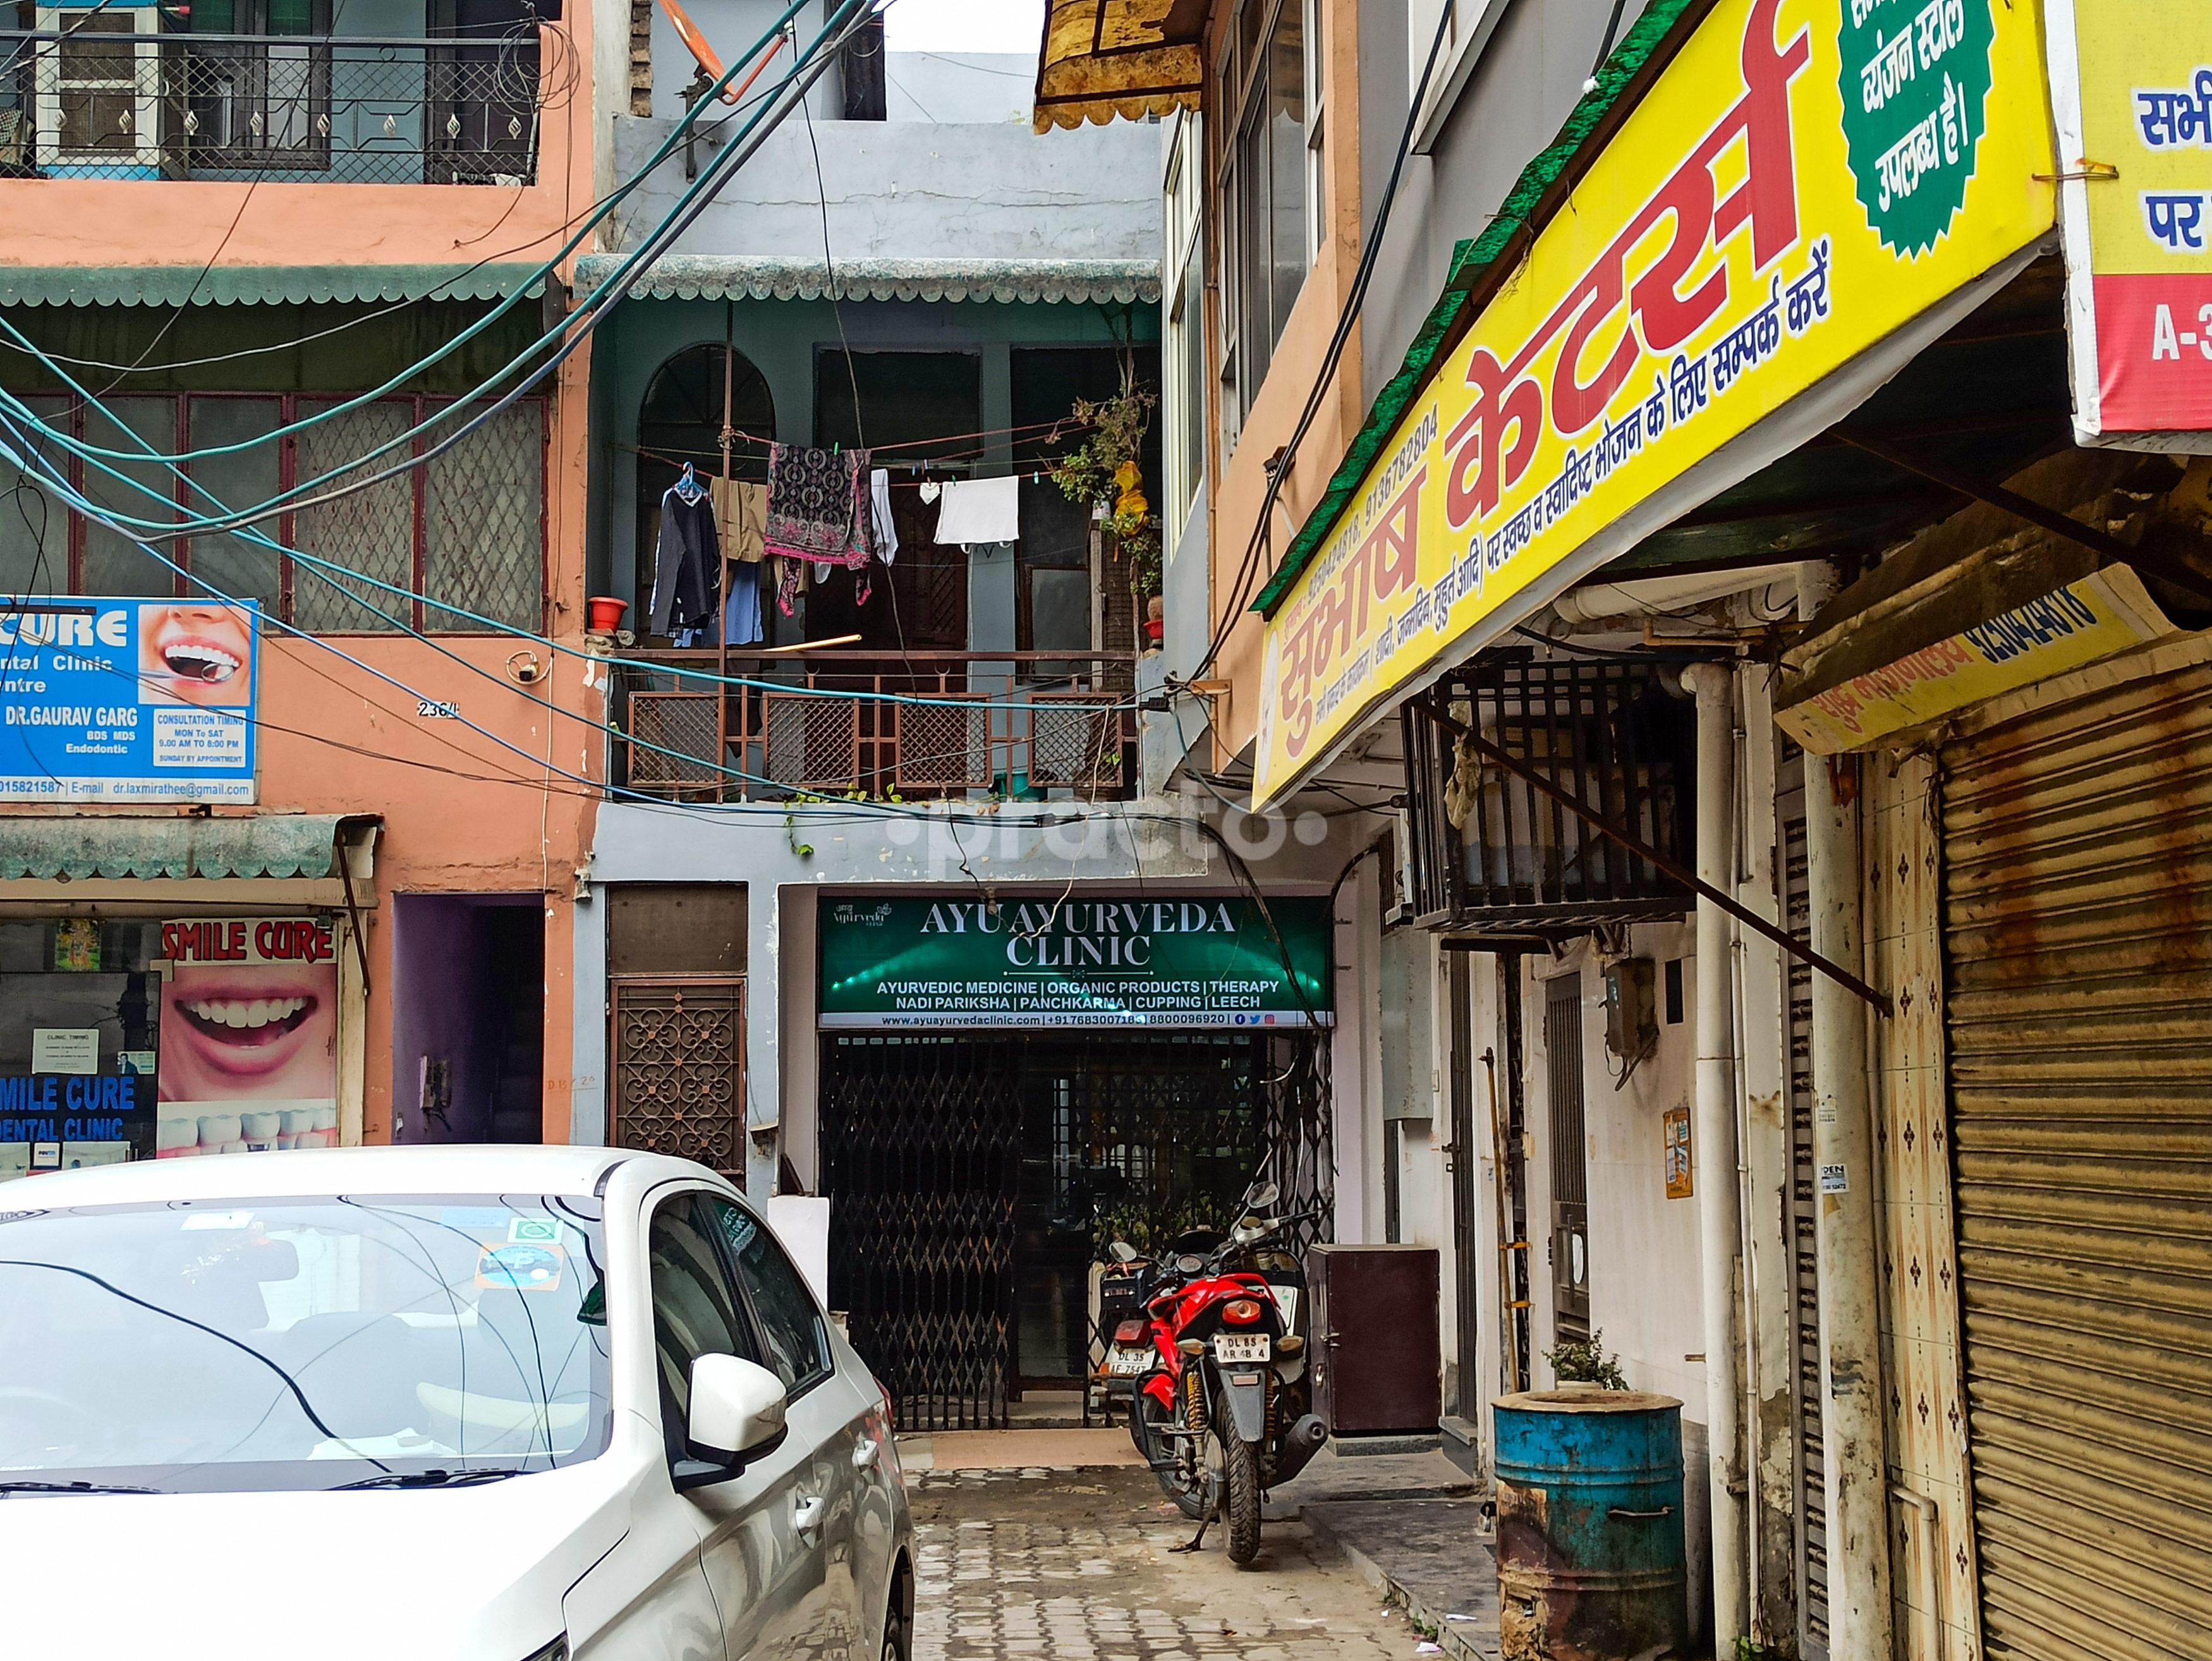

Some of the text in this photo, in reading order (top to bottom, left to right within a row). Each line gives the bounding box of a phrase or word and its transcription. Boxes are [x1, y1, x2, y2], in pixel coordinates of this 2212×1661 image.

[1860, 23, 1915, 113] व्यंजन
[1875, 111, 1940, 212] उपलब्ध
[2146, 196, 2203, 248] पर
[1280, 0, 1810, 758] सुभाष केटर्स
[1486, 532, 1504, 570] पर
[1503, 504, 1532, 558] स्वच्छ
[1533, 496, 1543, 532] व
[1545, 449, 1593, 525] स्वादिष्ट
[1595, 419, 1642, 478] भोजन
[1646, 374, 1666, 437] के
[1670, 354, 1707, 423] लिए
[1711, 275, 1779, 392] सम्पर्क
[1785, 239, 1828, 332] करें
[1366, 403, 1438, 526] 9136782804
[53, 655, 112, 671] Clinic
[0, 678, 46, 692] ntre
[6, 706, 138, 726] DR.GAURAV GARG
[158, 714, 215, 725] CONSULTATION
[87, 731, 136, 741] BDS MDS
[66, 743, 128, 753] Endodontic
[71, 781, 104, 794] E-mail
[113, 782, 249, 798] dr.laxmirathee@gmail.com
[920, 903, 1236, 934] AYU AYURVEDA
[162, 921, 334, 964] SMILE CURE
[1006, 935, 1151, 966] CLINIC
[877, 981, 1279, 994] AYURVEDIC MEDICINE ORGANIC PRODUCTS THERAPY
[896, 996, 1260, 1009] NADI PARIKSHA PANCHKARMA CUPPING LEECH
[882, 1016, 1040, 1026] www.ayuayurvedaclinic.com
[1150, 1014, 1224, 1024] 8800096920
[66, 1076, 135, 1110] CURE
[0, 1117, 123, 1141] ENTAL CLINIC
[1228, 1338, 1240, 1348] DL
[1119, 1353, 1145, 1361] DL 3S
[1223, 1349, 1236, 1359] AR
